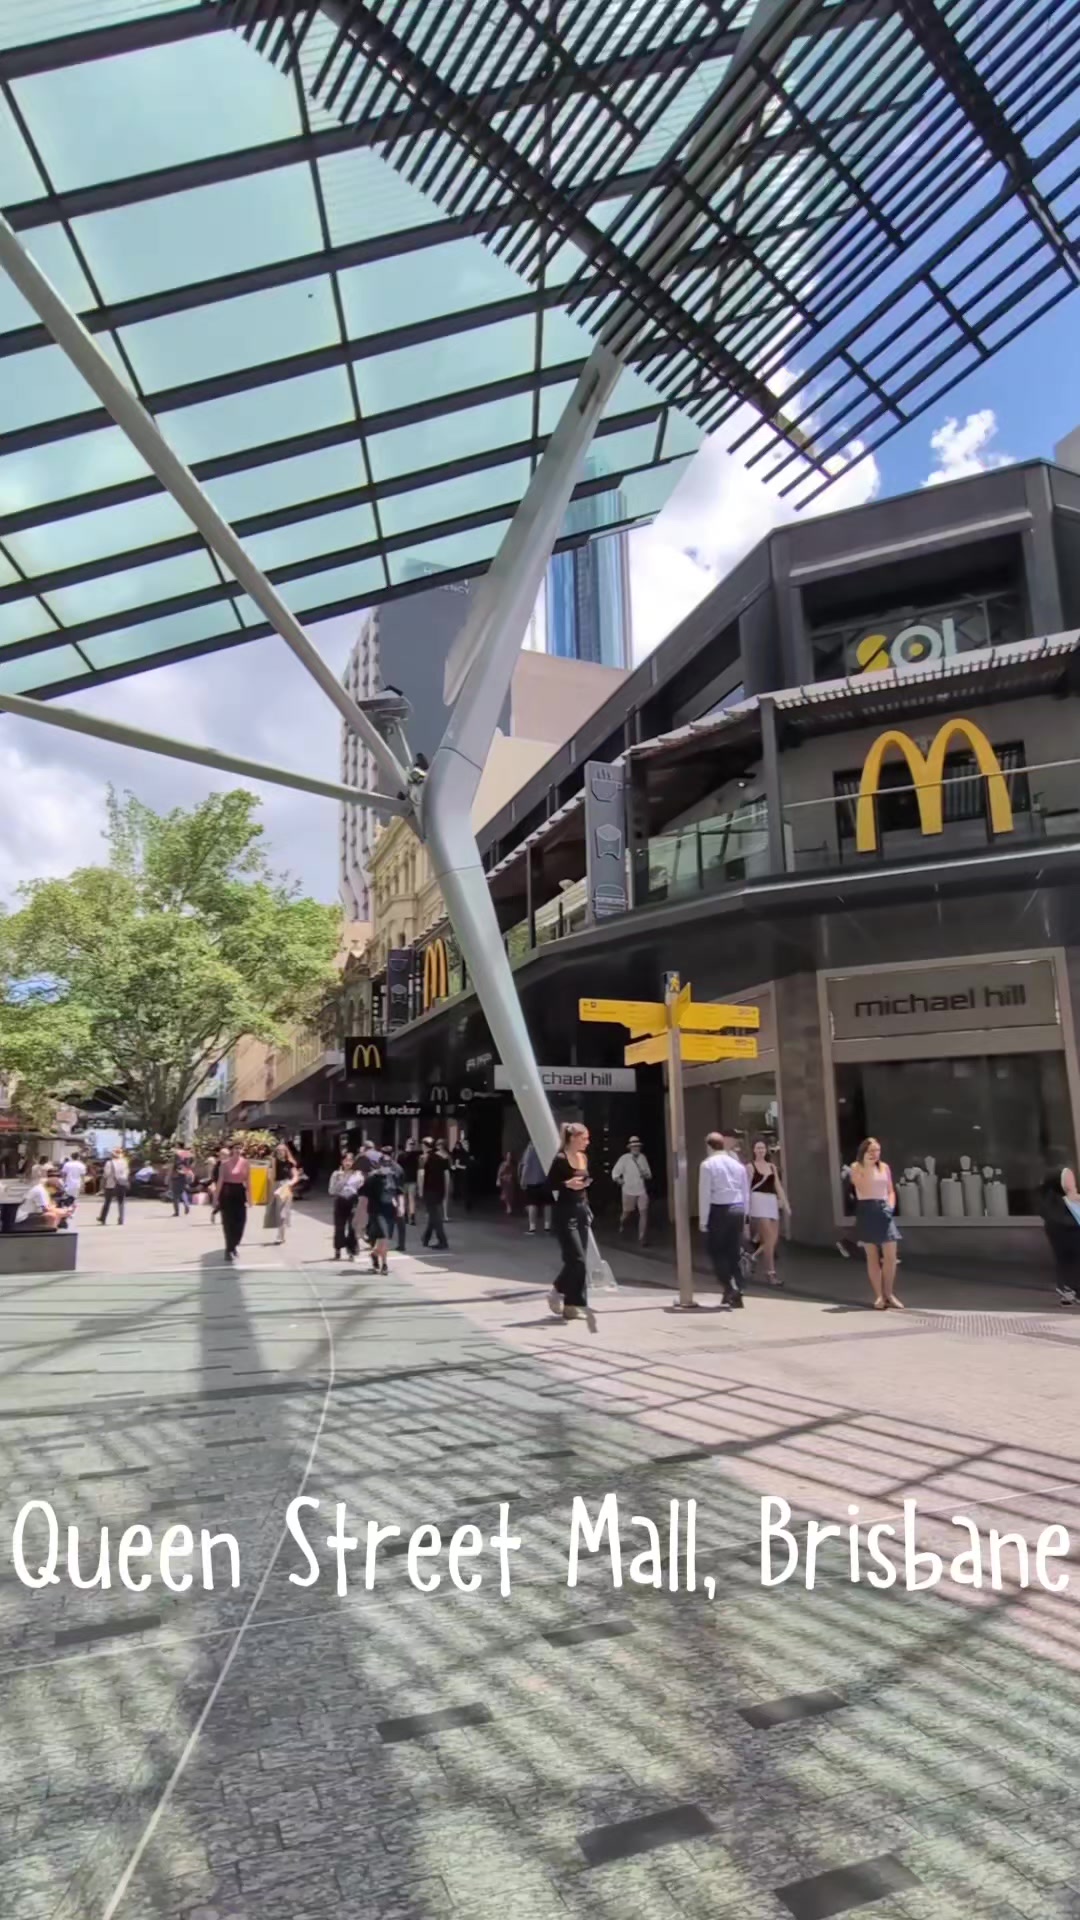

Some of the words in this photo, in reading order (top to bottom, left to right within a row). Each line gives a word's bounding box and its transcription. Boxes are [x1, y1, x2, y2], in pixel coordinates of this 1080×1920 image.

[854, 987, 976, 1018] michael
[984, 984, 1026, 1008] hill
[541, 1071, 587, 1086] chael
[591, 1072, 612, 1087] hill
[356, 1104, 381, 1115] Foot
[384, 1104, 421, 1115] Locker
